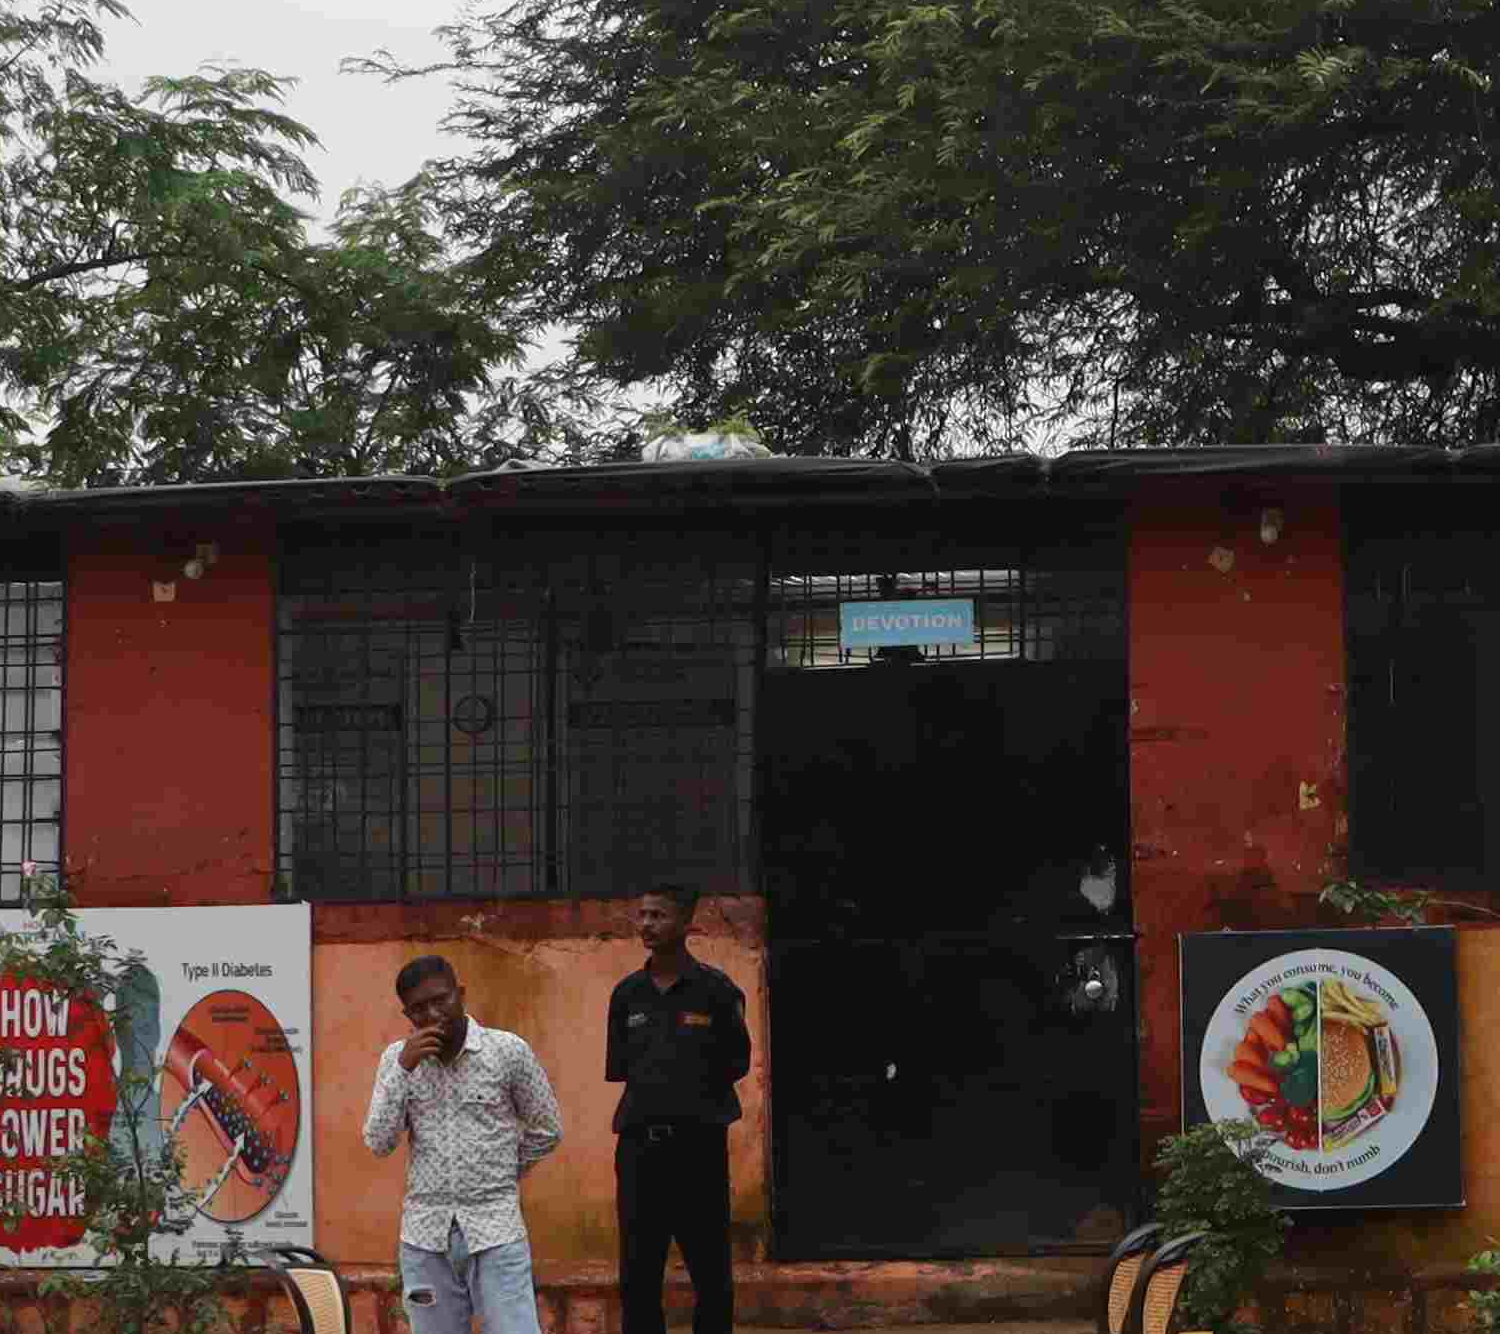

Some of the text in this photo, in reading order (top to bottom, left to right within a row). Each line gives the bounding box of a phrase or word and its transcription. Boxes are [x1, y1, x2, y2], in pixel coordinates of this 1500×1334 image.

[852, 611, 964, 631] DEVOTION
[181, 961, 273, 982] Type II Diabetes
[1234, 987, 1262, 1014] What
[1262, 975, 1283, 993] you
[1341, 966, 1362, 980] you
[1363, 972, 1399, 1011] become
[1, 988, 69, 1038] HOW
[1347, 1144, 1381, 1170] numb
